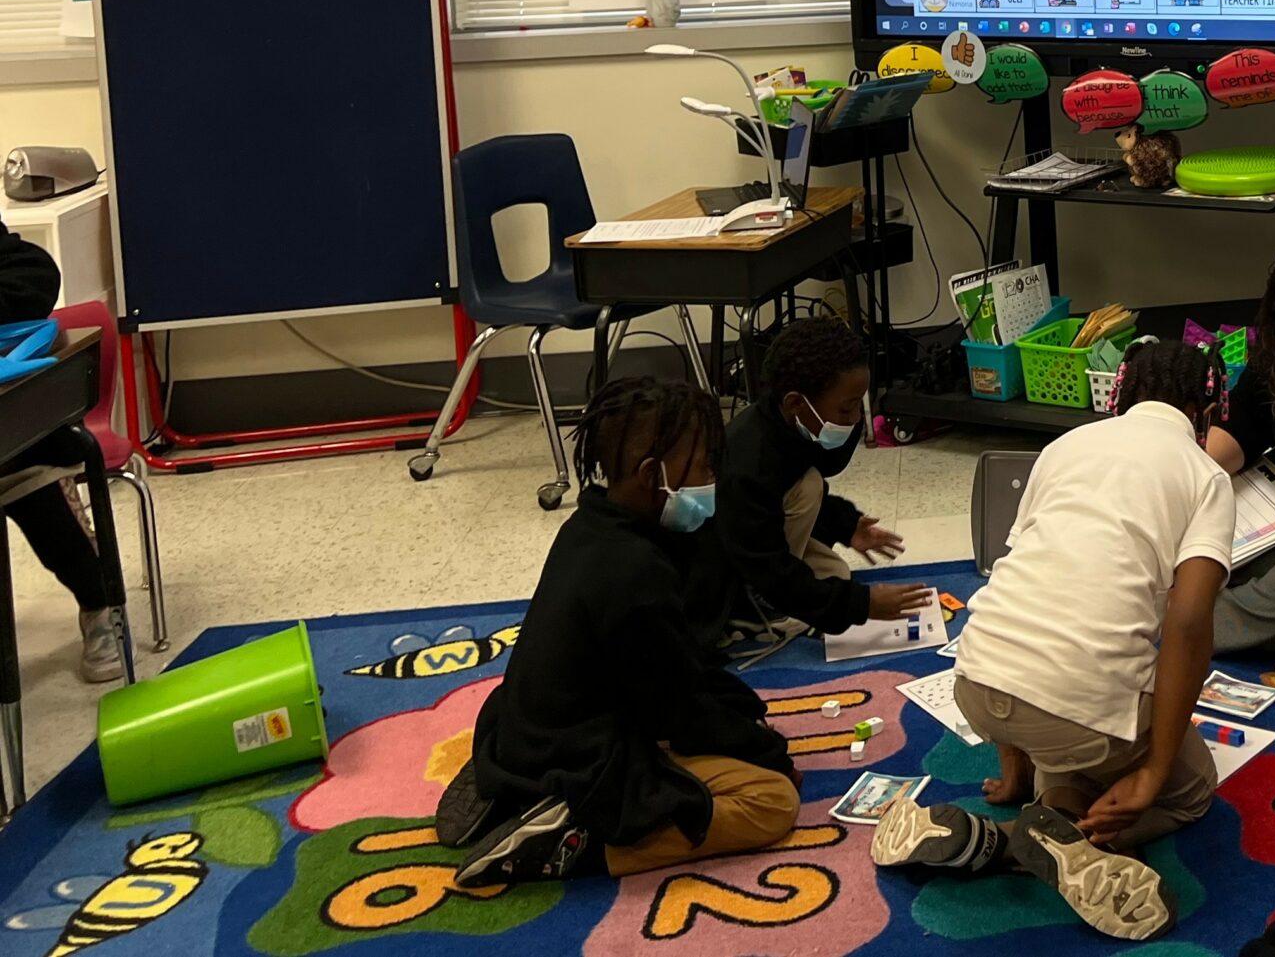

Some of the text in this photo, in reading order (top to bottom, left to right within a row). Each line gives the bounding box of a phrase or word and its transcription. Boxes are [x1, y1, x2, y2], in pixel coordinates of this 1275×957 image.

[998, 52, 1027, 64] would
[1232, 53, 1260, 68] This
[980, 828, 997, 861] NIKE
